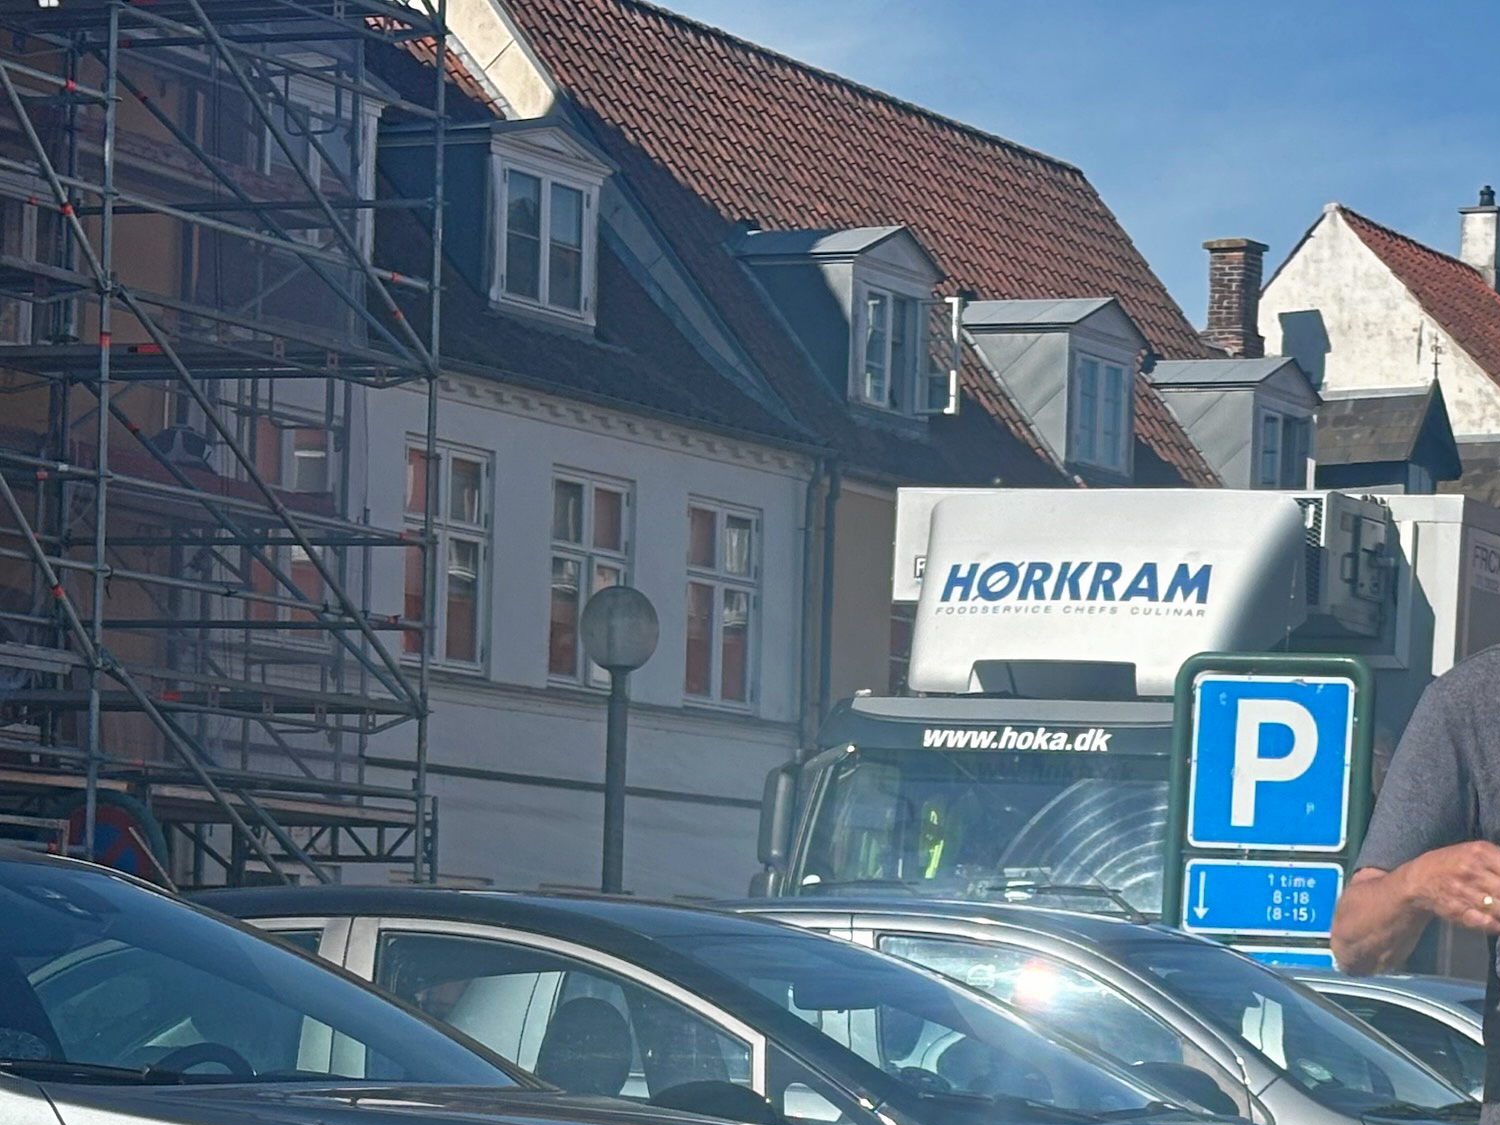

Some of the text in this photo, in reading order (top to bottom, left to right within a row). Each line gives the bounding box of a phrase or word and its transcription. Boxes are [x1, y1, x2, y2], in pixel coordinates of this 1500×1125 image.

[940, 560, 1212, 604] HØRKRAM
[935, 605, 1206, 618] FOODSERVICE CHEFS CULINAR
[923, 726, 1112, 752] www.hoka.dk
[1230, 698, 1319, 827] P
[1268, 873, 1316, 888] 1 time
[1272, 890, 1309, 905] 8-18
[1266, 906, 1316, 923] (8-15)
